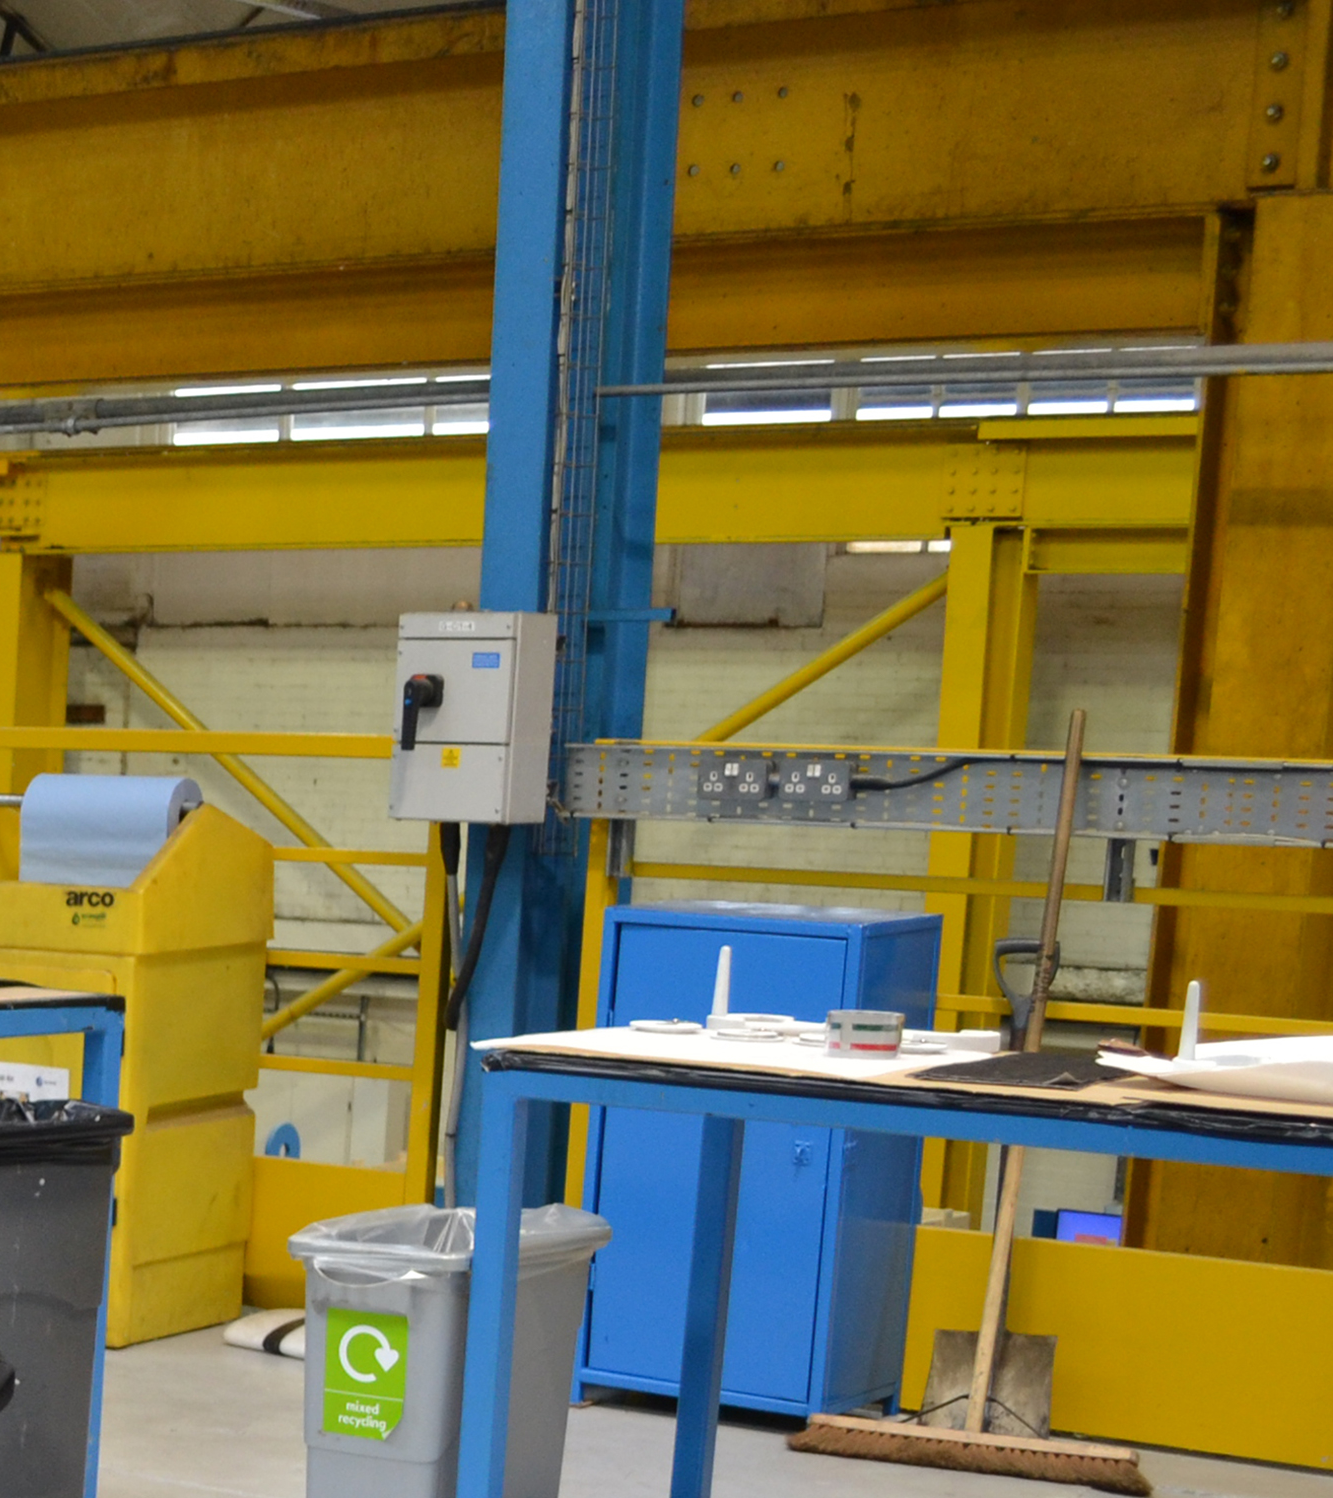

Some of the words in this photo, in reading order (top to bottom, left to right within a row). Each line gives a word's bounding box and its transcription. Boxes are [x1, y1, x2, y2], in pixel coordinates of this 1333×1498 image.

[66, 890, 115, 907] arco
[346, 1399, 380, 1415] mixed
[338, 1414, 387, 1432] recycling
